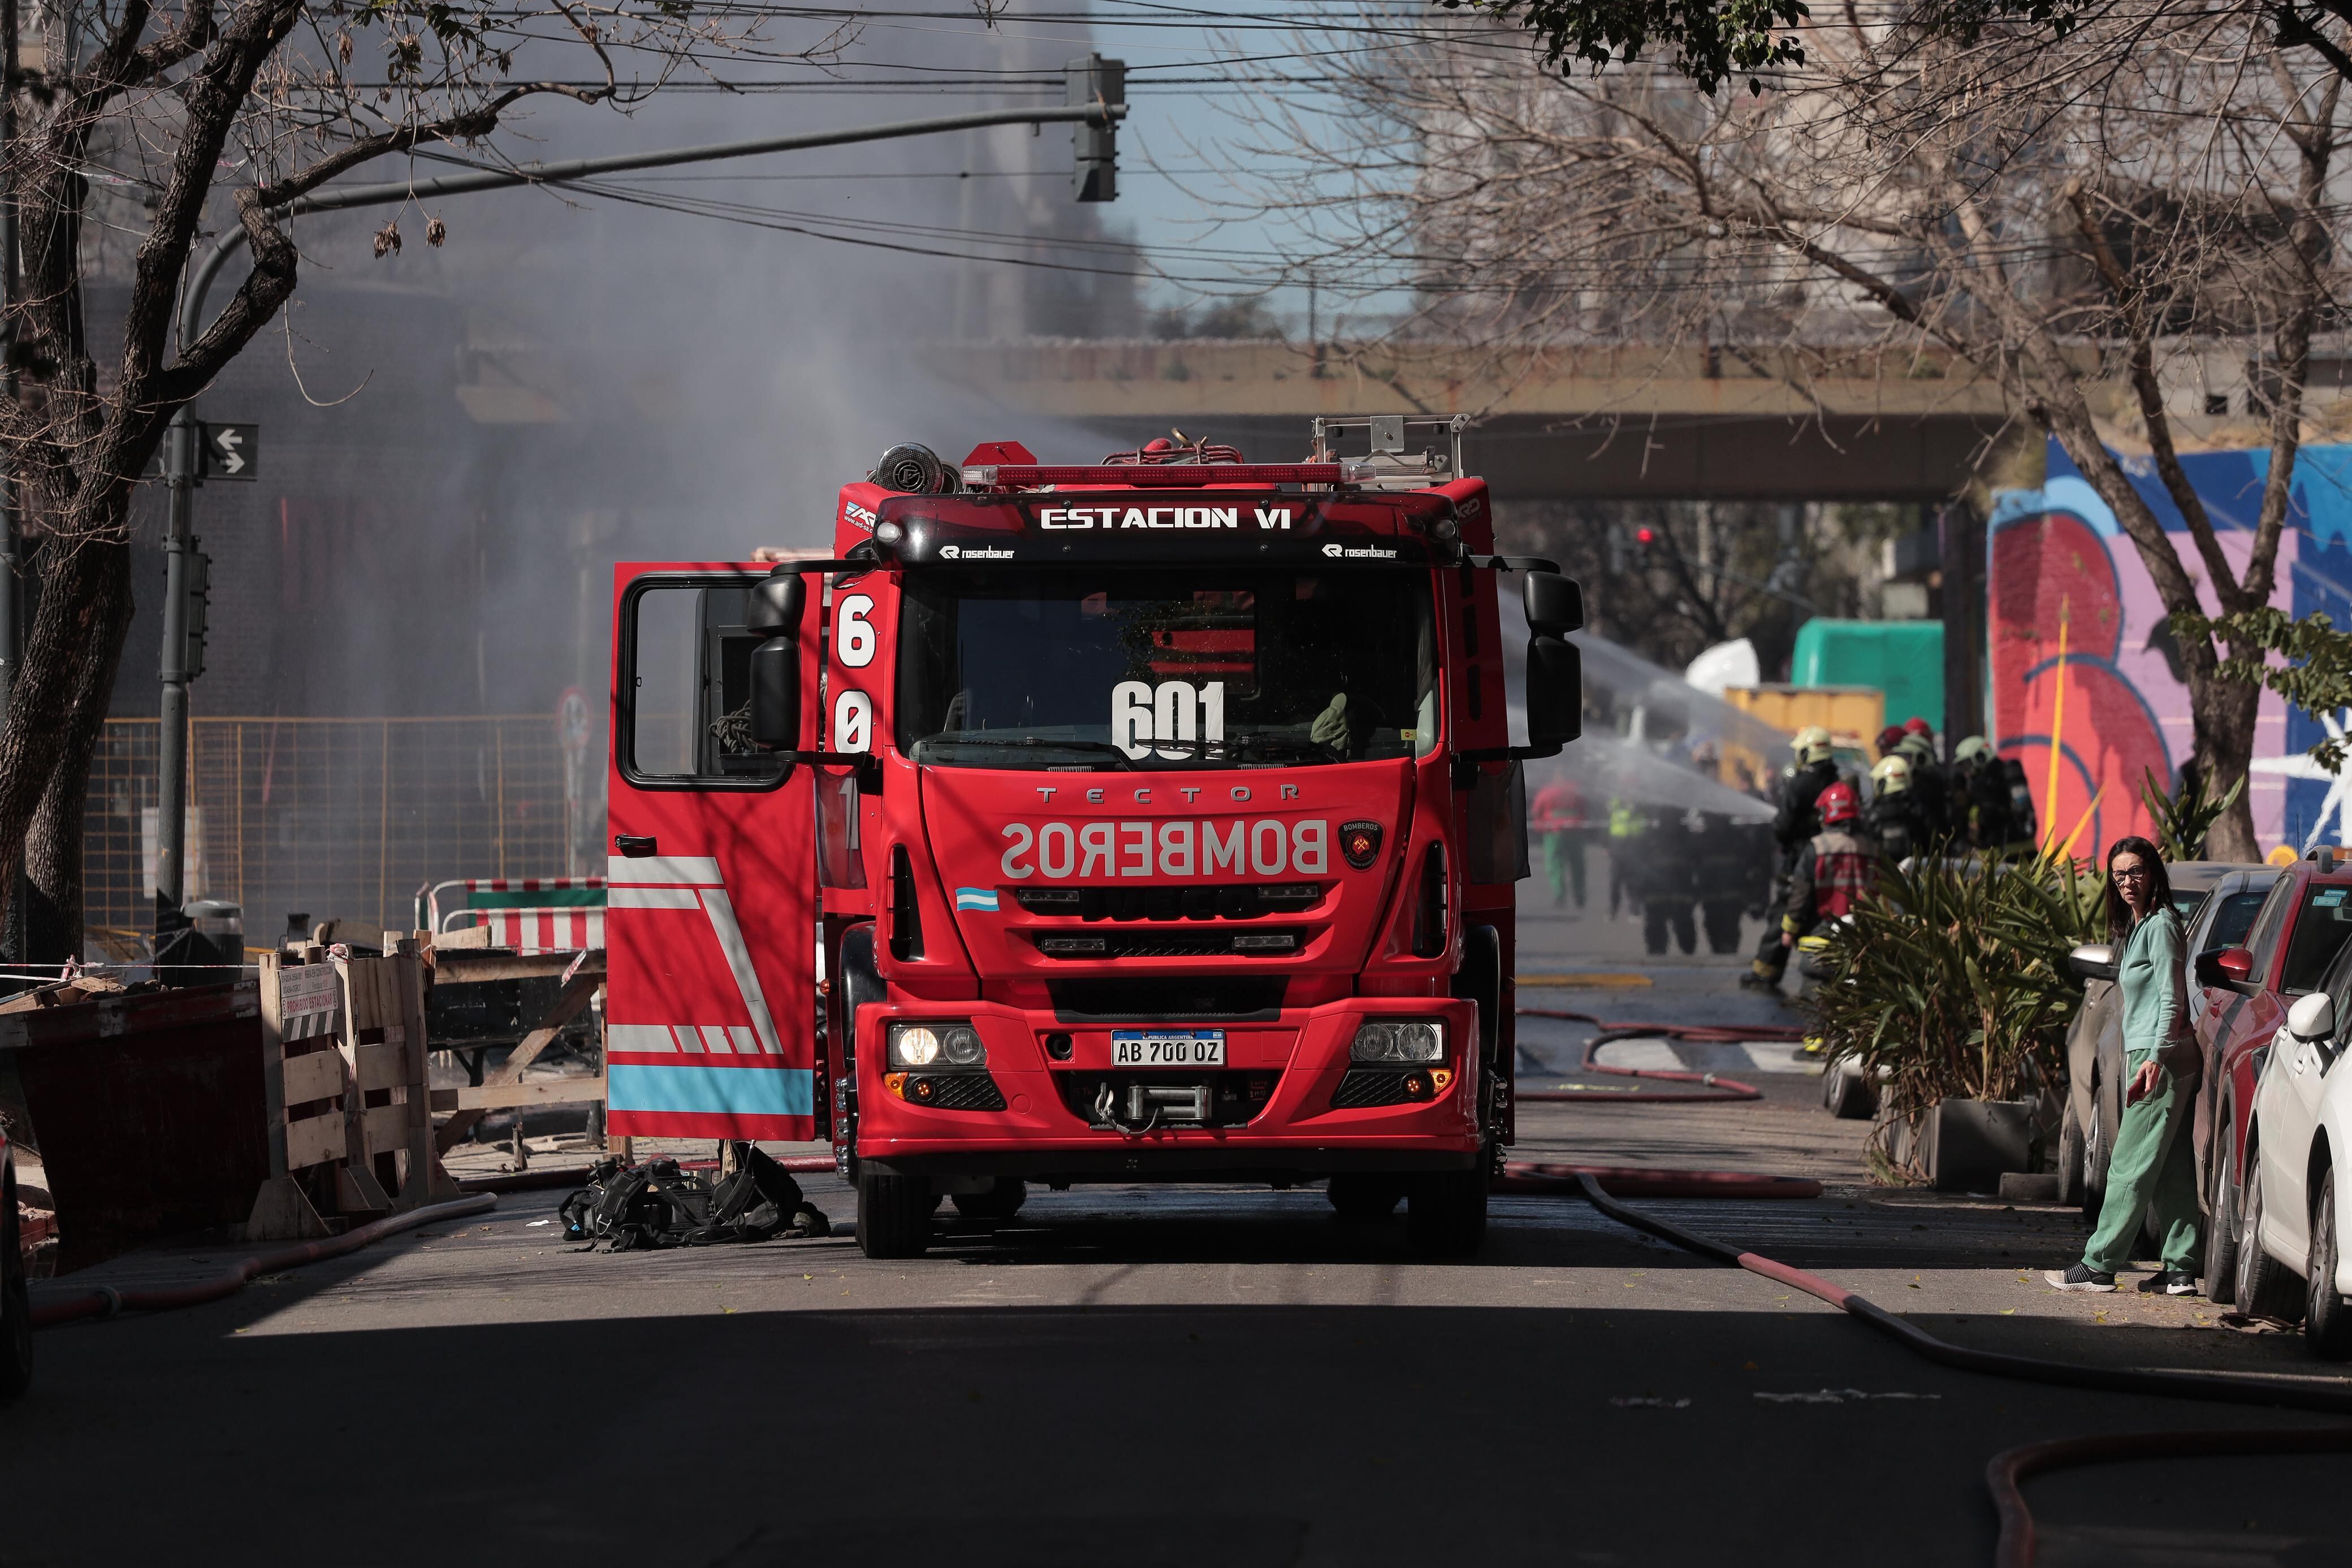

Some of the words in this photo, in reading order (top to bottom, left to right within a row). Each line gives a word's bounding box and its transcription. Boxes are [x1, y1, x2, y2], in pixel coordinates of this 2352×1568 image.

[1040, 507, 1238, 529] ESTACION
[1253, 508, 1291, 529] VI
[962, 545, 1015, 559] rosenbauer
[1344, 544, 1397, 558] rosenbauer
[1112, 681, 1224, 760] 601
[1036, 784, 1300, 804] TECTOR
[1343, 822, 1378, 831] BOMBEROS
[287, 998, 309, 1013] PROHIBIDO
[309, 993, 332, 1010] ESTACIONAR
[1117, 1042, 1142, 1062] AB
[1149, 1042, 1187, 1062] 700
